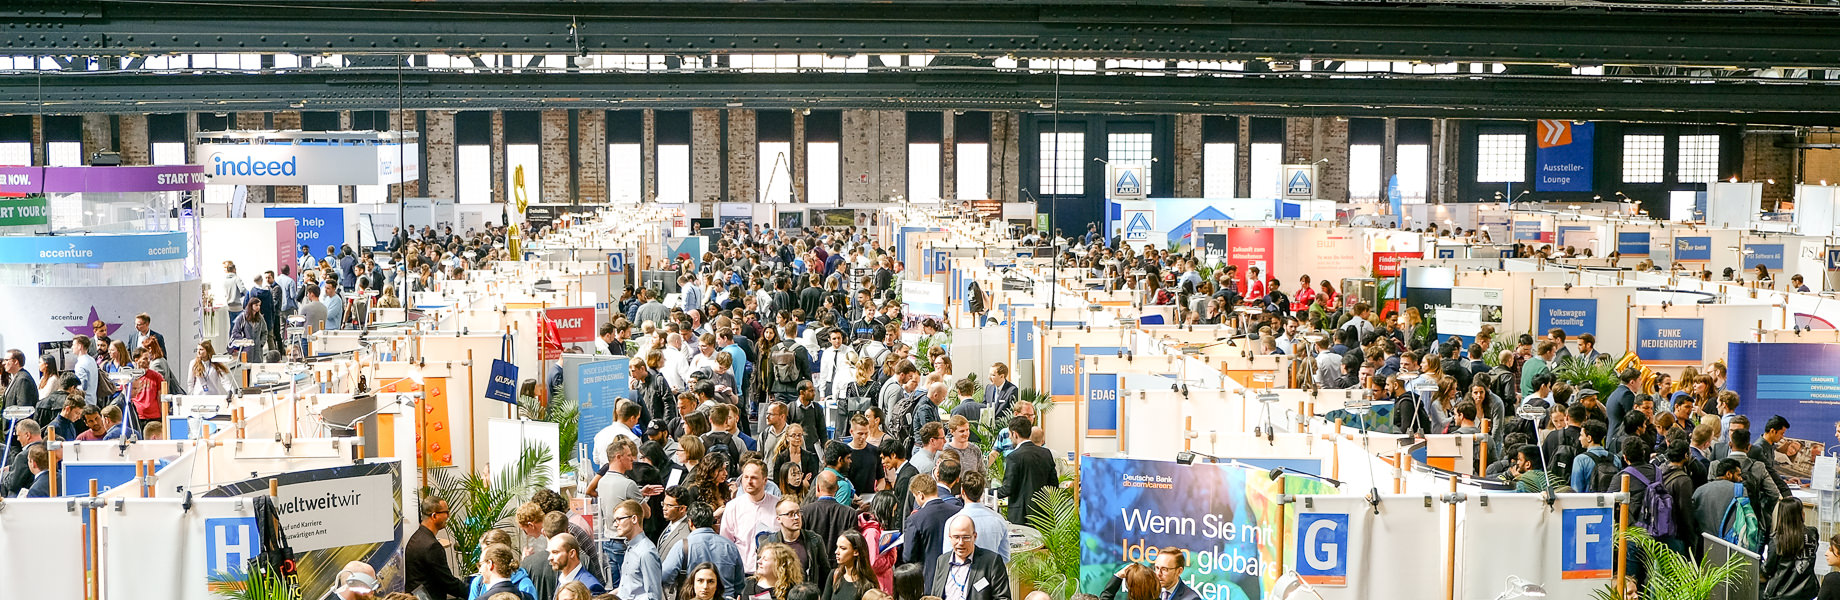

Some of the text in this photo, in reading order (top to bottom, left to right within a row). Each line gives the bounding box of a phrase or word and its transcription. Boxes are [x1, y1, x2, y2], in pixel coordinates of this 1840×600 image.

[215, 155, 297, 177] indeed
[1543, 163, 1584, 172] Aussteller-
[8, 174, 32, 185] NOW.
[157, 173, 188, 184] START
[1543, 176, 1571, 185] Lounge
[17, 206, 41, 218] YOUR
[303, 217, 325, 229] help
[297, 230, 320, 242] ople
[39, 247, 93, 258] accenture
[609, 255, 623, 273] Q
[938, 254, 947, 270] R
[51, 312, 84, 321] accenture
[1549, 308, 1586, 318] Volkswagen
[1550, 317, 1584, 326] Consulting
[1657, 328, 1682, 338] FUNKE
[1641, 339, 1698, 349] MEDIENGRUPPE
[1091, 389, 1116, 401] EDAG
[1122, 473, 1173, 484] Deutsche Bank
[1122, 481, 1174, 491] db.com/careers
[290, 522, 301, 531] und
[301, 519, 323, 530] Karriere
[1120, 507, 1275, 548] Wenn Sie mit
[315, 528, 328, 536] Amt
[1303, 518, 1340, 571] G
[1574, 514, 1604, 565] F
[214, 524, 251, 576] H
[1121, 537, 1191, 564] Iden
